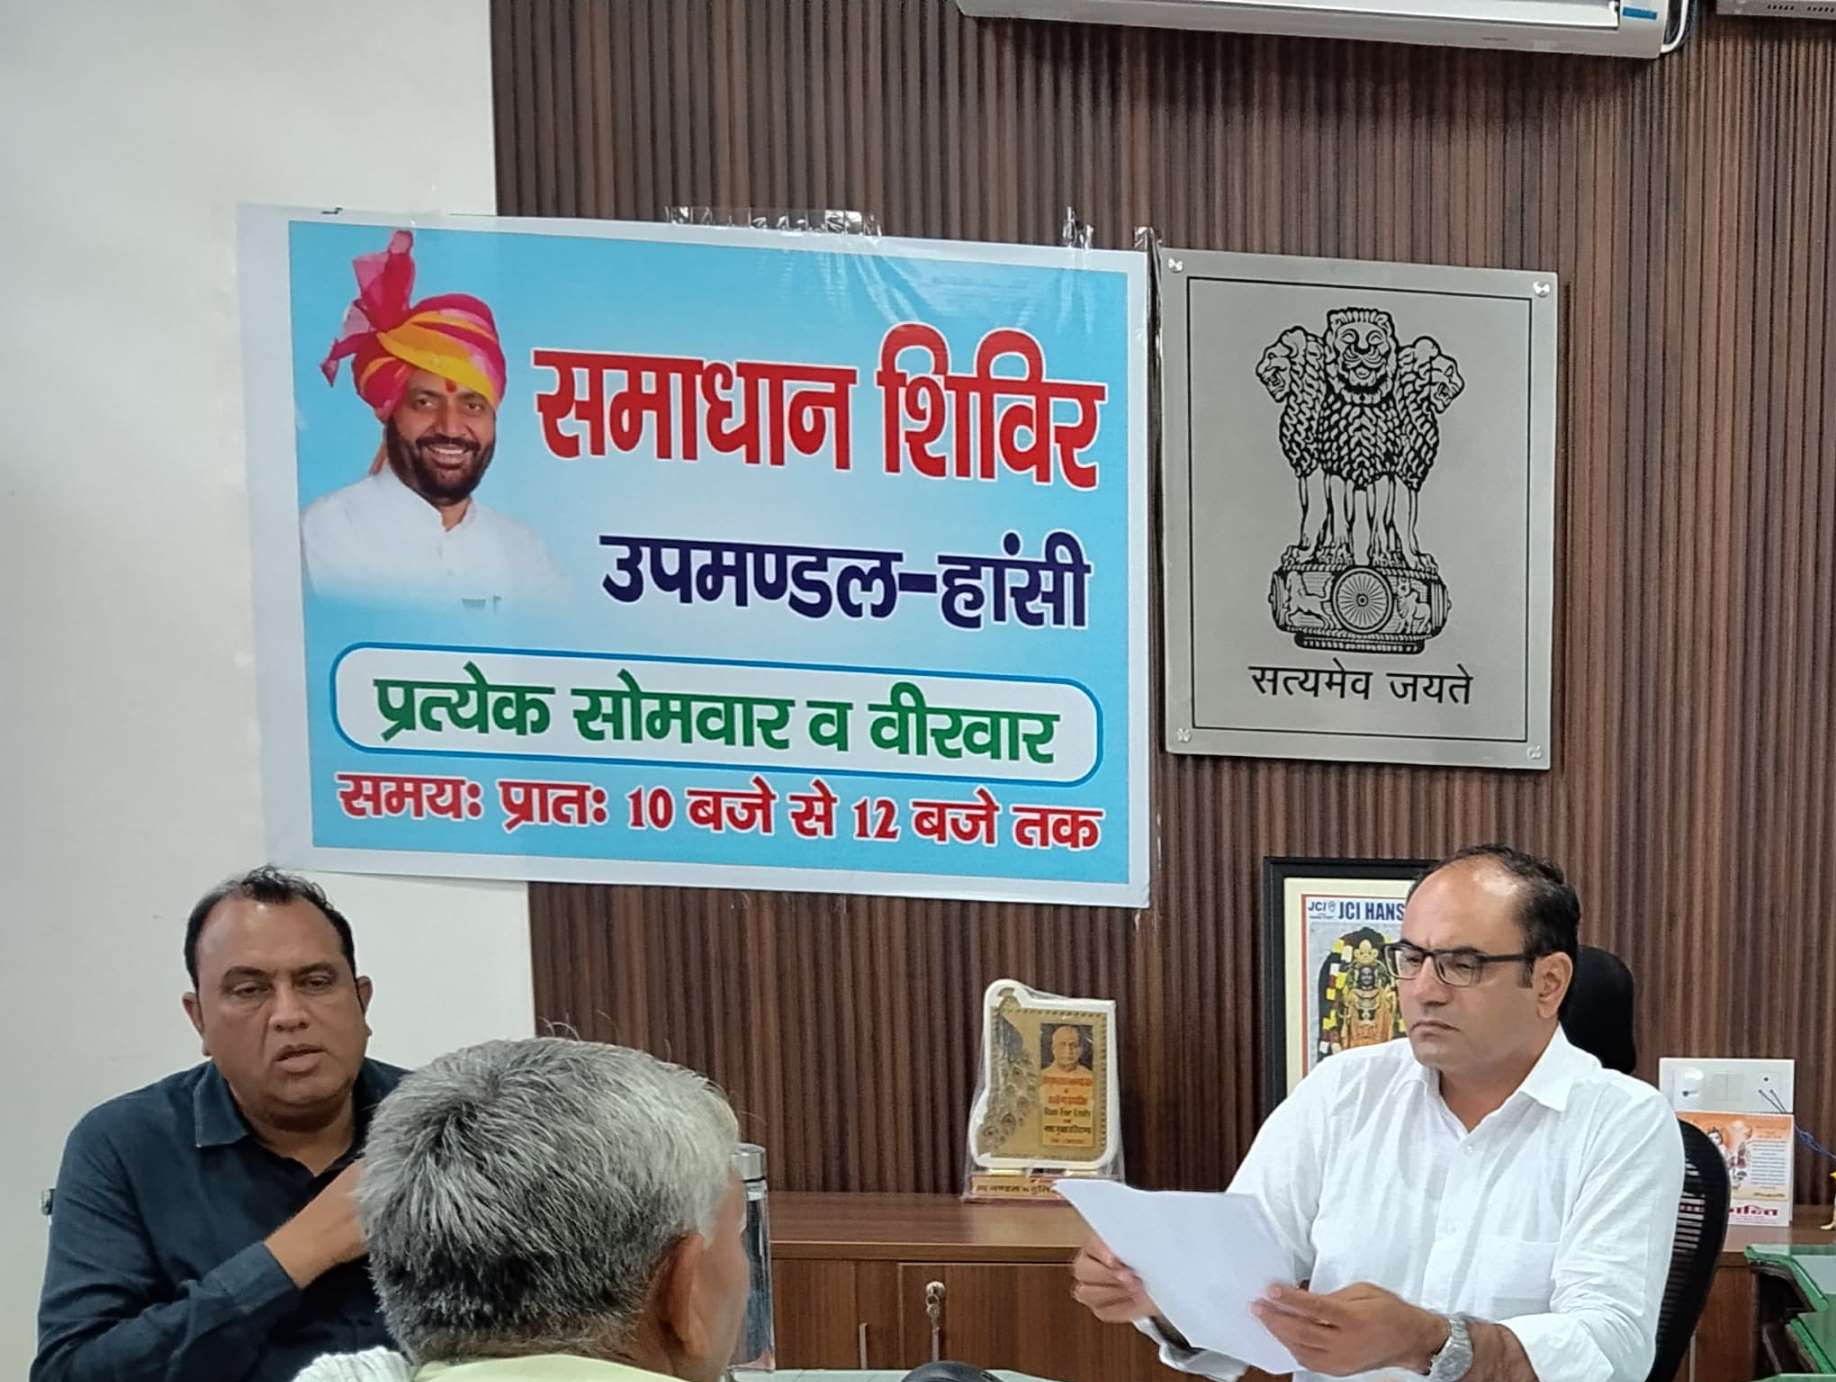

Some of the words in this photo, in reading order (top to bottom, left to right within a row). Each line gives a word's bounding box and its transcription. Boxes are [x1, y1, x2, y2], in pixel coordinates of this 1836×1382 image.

[533, 350, 857, 471] समाधान
[876, 323, 1106, 489] शिविर
[373, 660, 557, 743] प्रत्येक
[569, 669, 796, 751] सोमवार
[805, 699, 854, 753] व
[866, 680, 1061, 765] वीरवार
[1247, 656, 1374, 700] सत्यमेव
[1385, 663, 1475, 706] जयते
[629, 788, 673, 829] 10
[686, 776, 776, 834] बजे
[789, 779, 837, 837] से
[854, 800, 898, 840] 12
[912, 788, 1000, 845] बजे
[1012, 806, 1103, 849] तक
[1308, 902, 1327, 911] JCI
[1338, 901, 1361, 920] JCI
[1365, 902, 1404, 921] HANS
